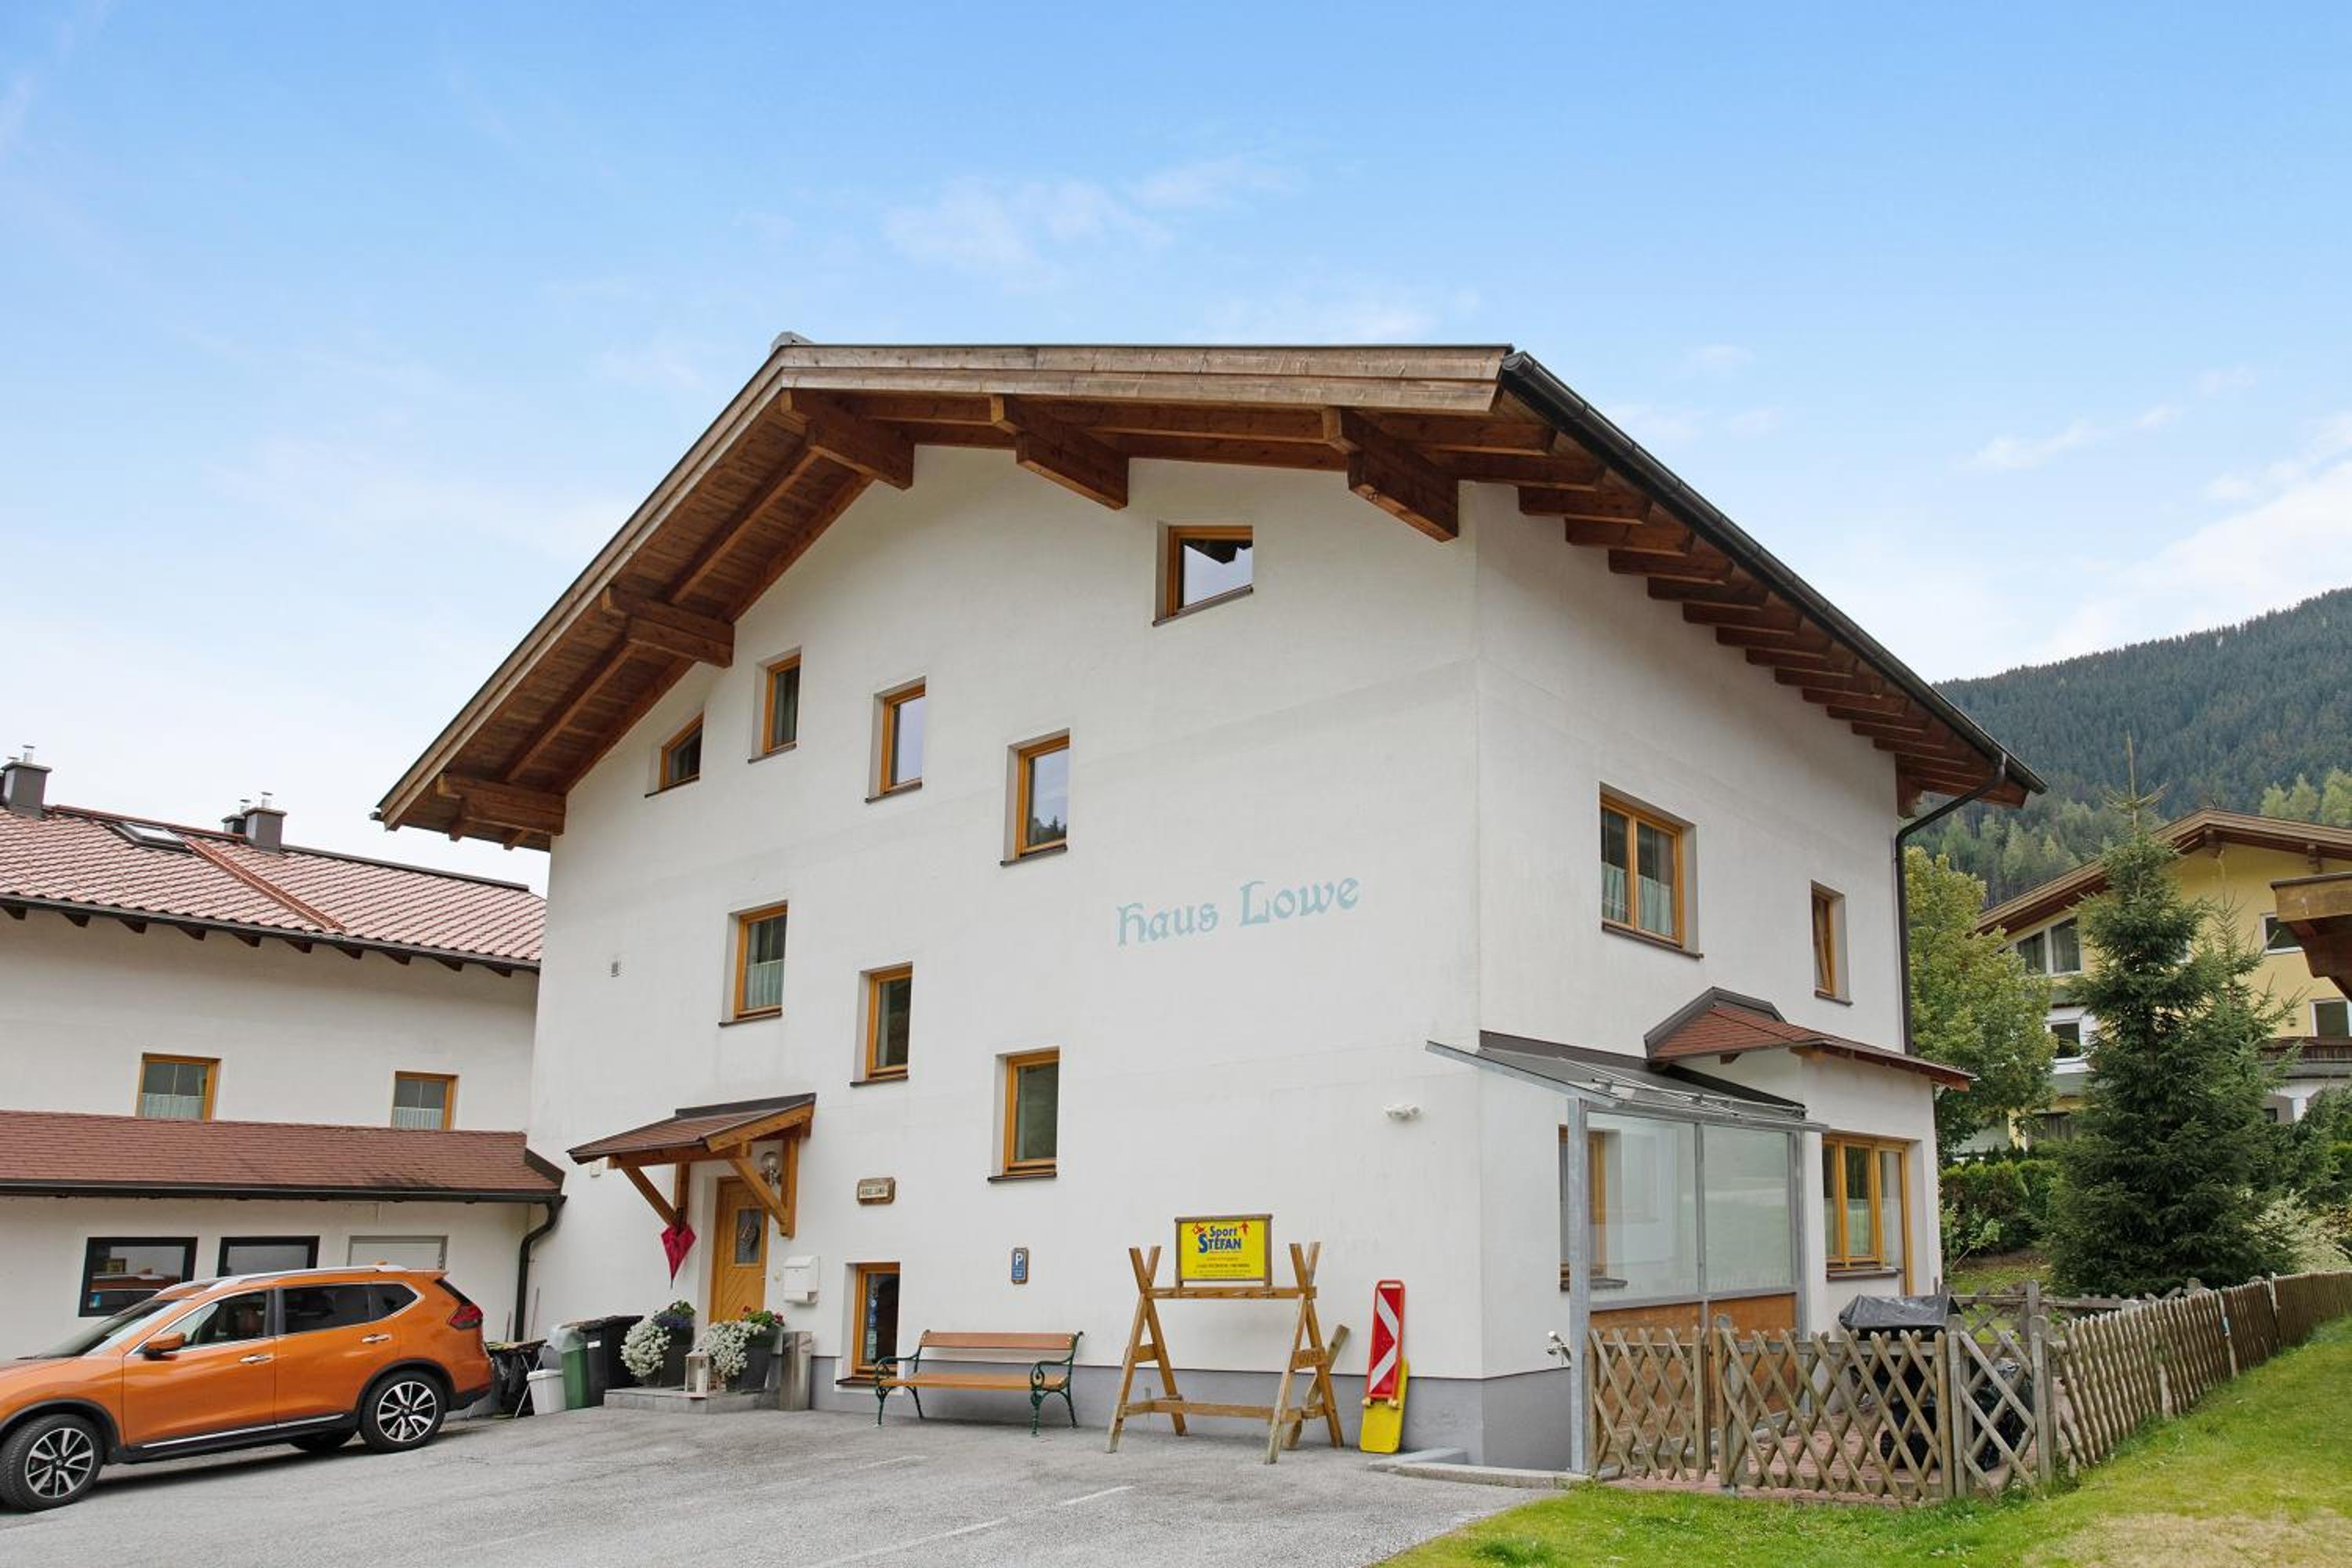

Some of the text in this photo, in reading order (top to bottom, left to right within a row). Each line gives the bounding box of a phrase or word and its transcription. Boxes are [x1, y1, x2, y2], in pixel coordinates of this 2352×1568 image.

[1116, 902, 1218, 946] Haus
[1209, 1225, 1237, 1238] Sport
[1197, 1232, 1243, 1254] STEFAN
[1015, 1253, 1023, 1266] P
